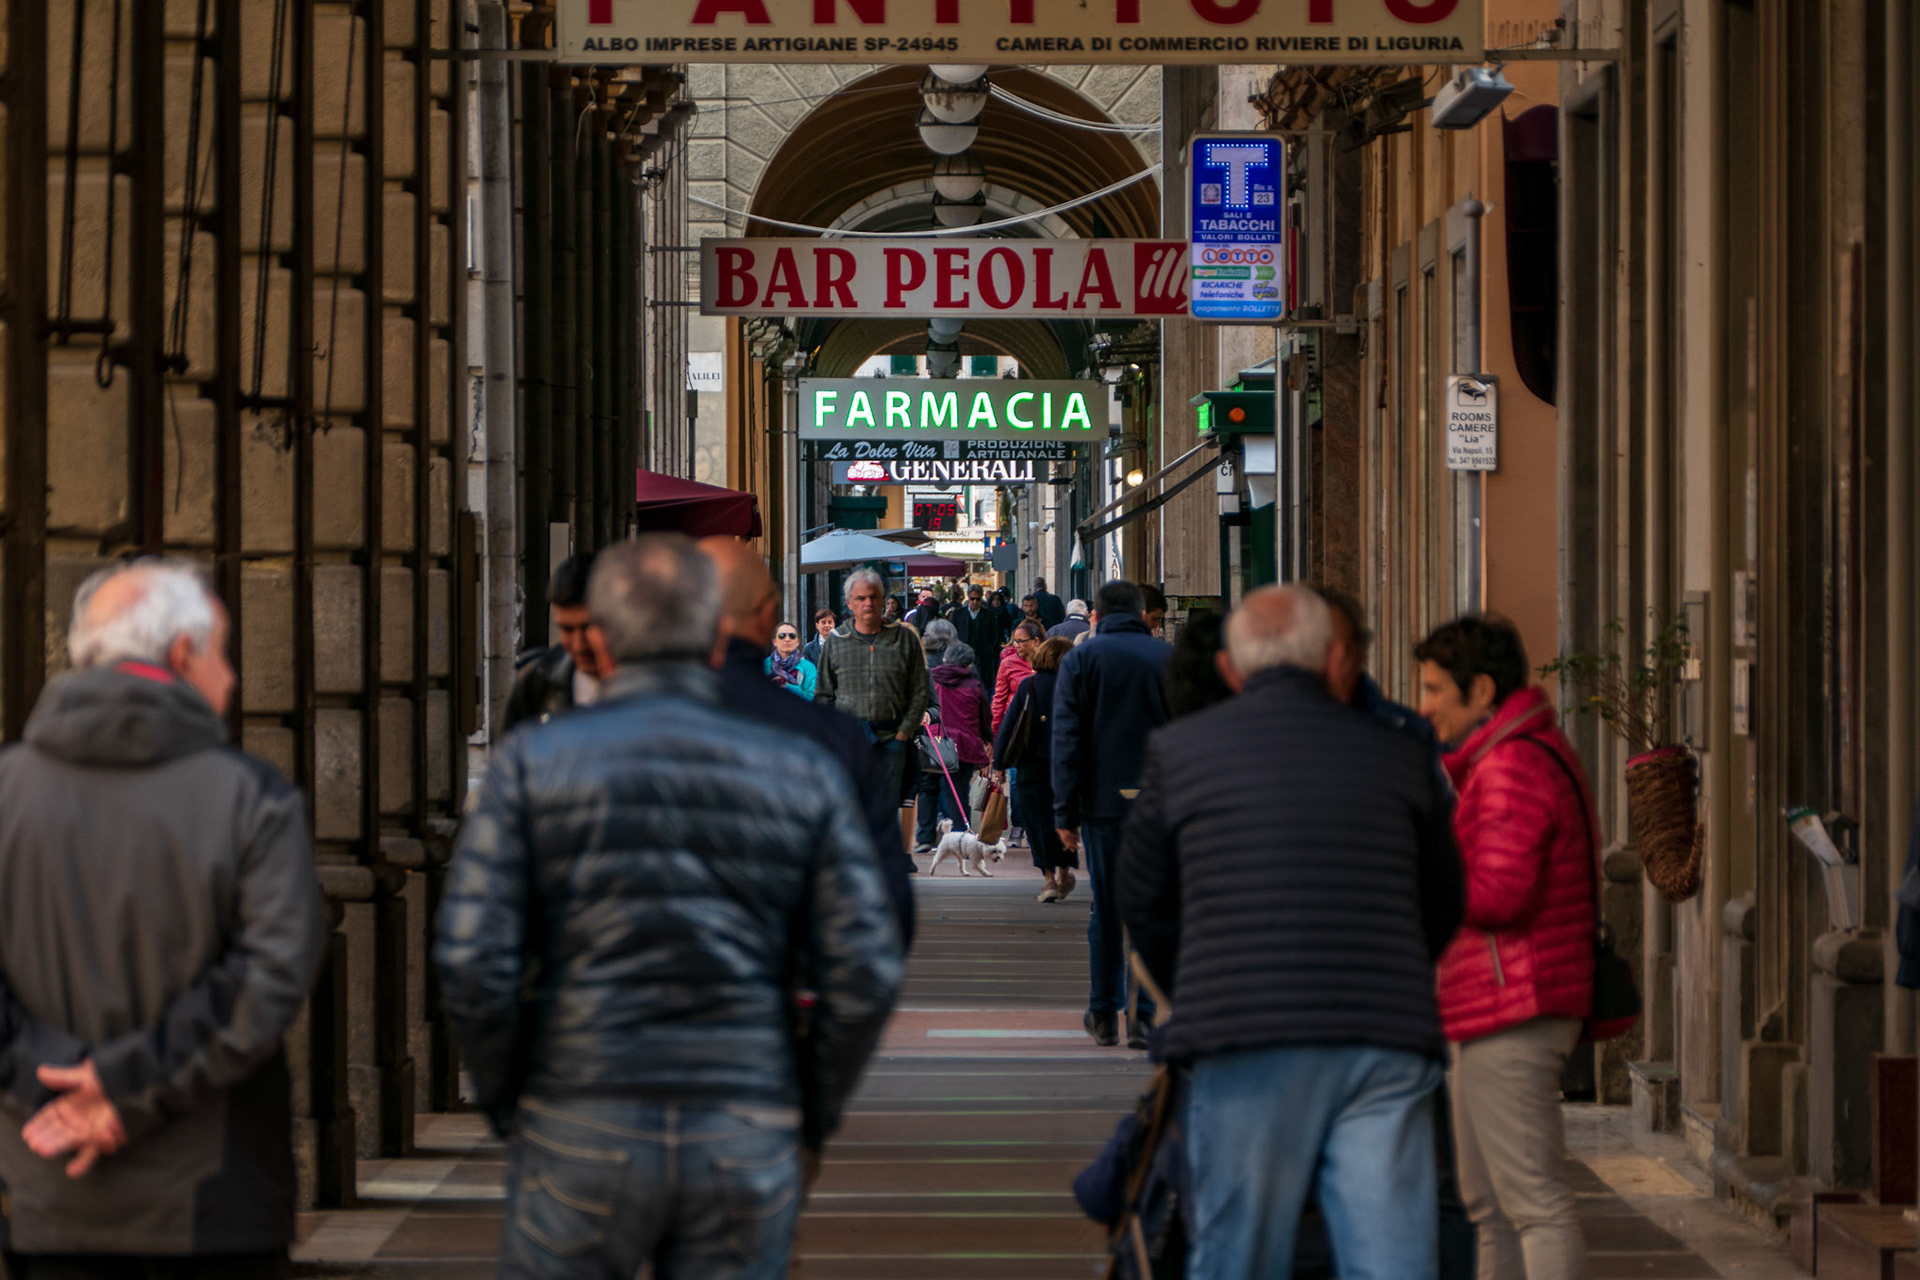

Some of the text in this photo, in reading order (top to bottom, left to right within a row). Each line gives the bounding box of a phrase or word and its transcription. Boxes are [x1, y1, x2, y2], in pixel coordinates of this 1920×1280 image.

[583, 37, 959, 52] ALBO IMPRESE ARTIGIANE SP-24945
[995, 37, 1464, 52] CAMERA DI COMMERCIO RIVIERE DI LIGURIA
[1206, 143, 1269, 209] T
[1257, 194, 1270, 203] 23
[1200, 219, 1275, 231] TABACCHI
[715, 247, 1122, 311] BAR PEOLA
[1140, 247, 1187, 310] ill
[1201, 281, 1244, 289] RICARICHE
[814, 390, 1092, 429] FARMACIA
[1452, 412, 1492, 421] ROOMS
[1449, 423, 1495, 433] CAMERE
[824, 441, 937, 459] La Dolce Vita
[967, 441, 1066, 449] PRODUZIONE
[967, 450, 1066, 459] ARTIGIANALE
[889, 460, 1037, 481] GENERALI
[928, 517, 942, 531] 19
